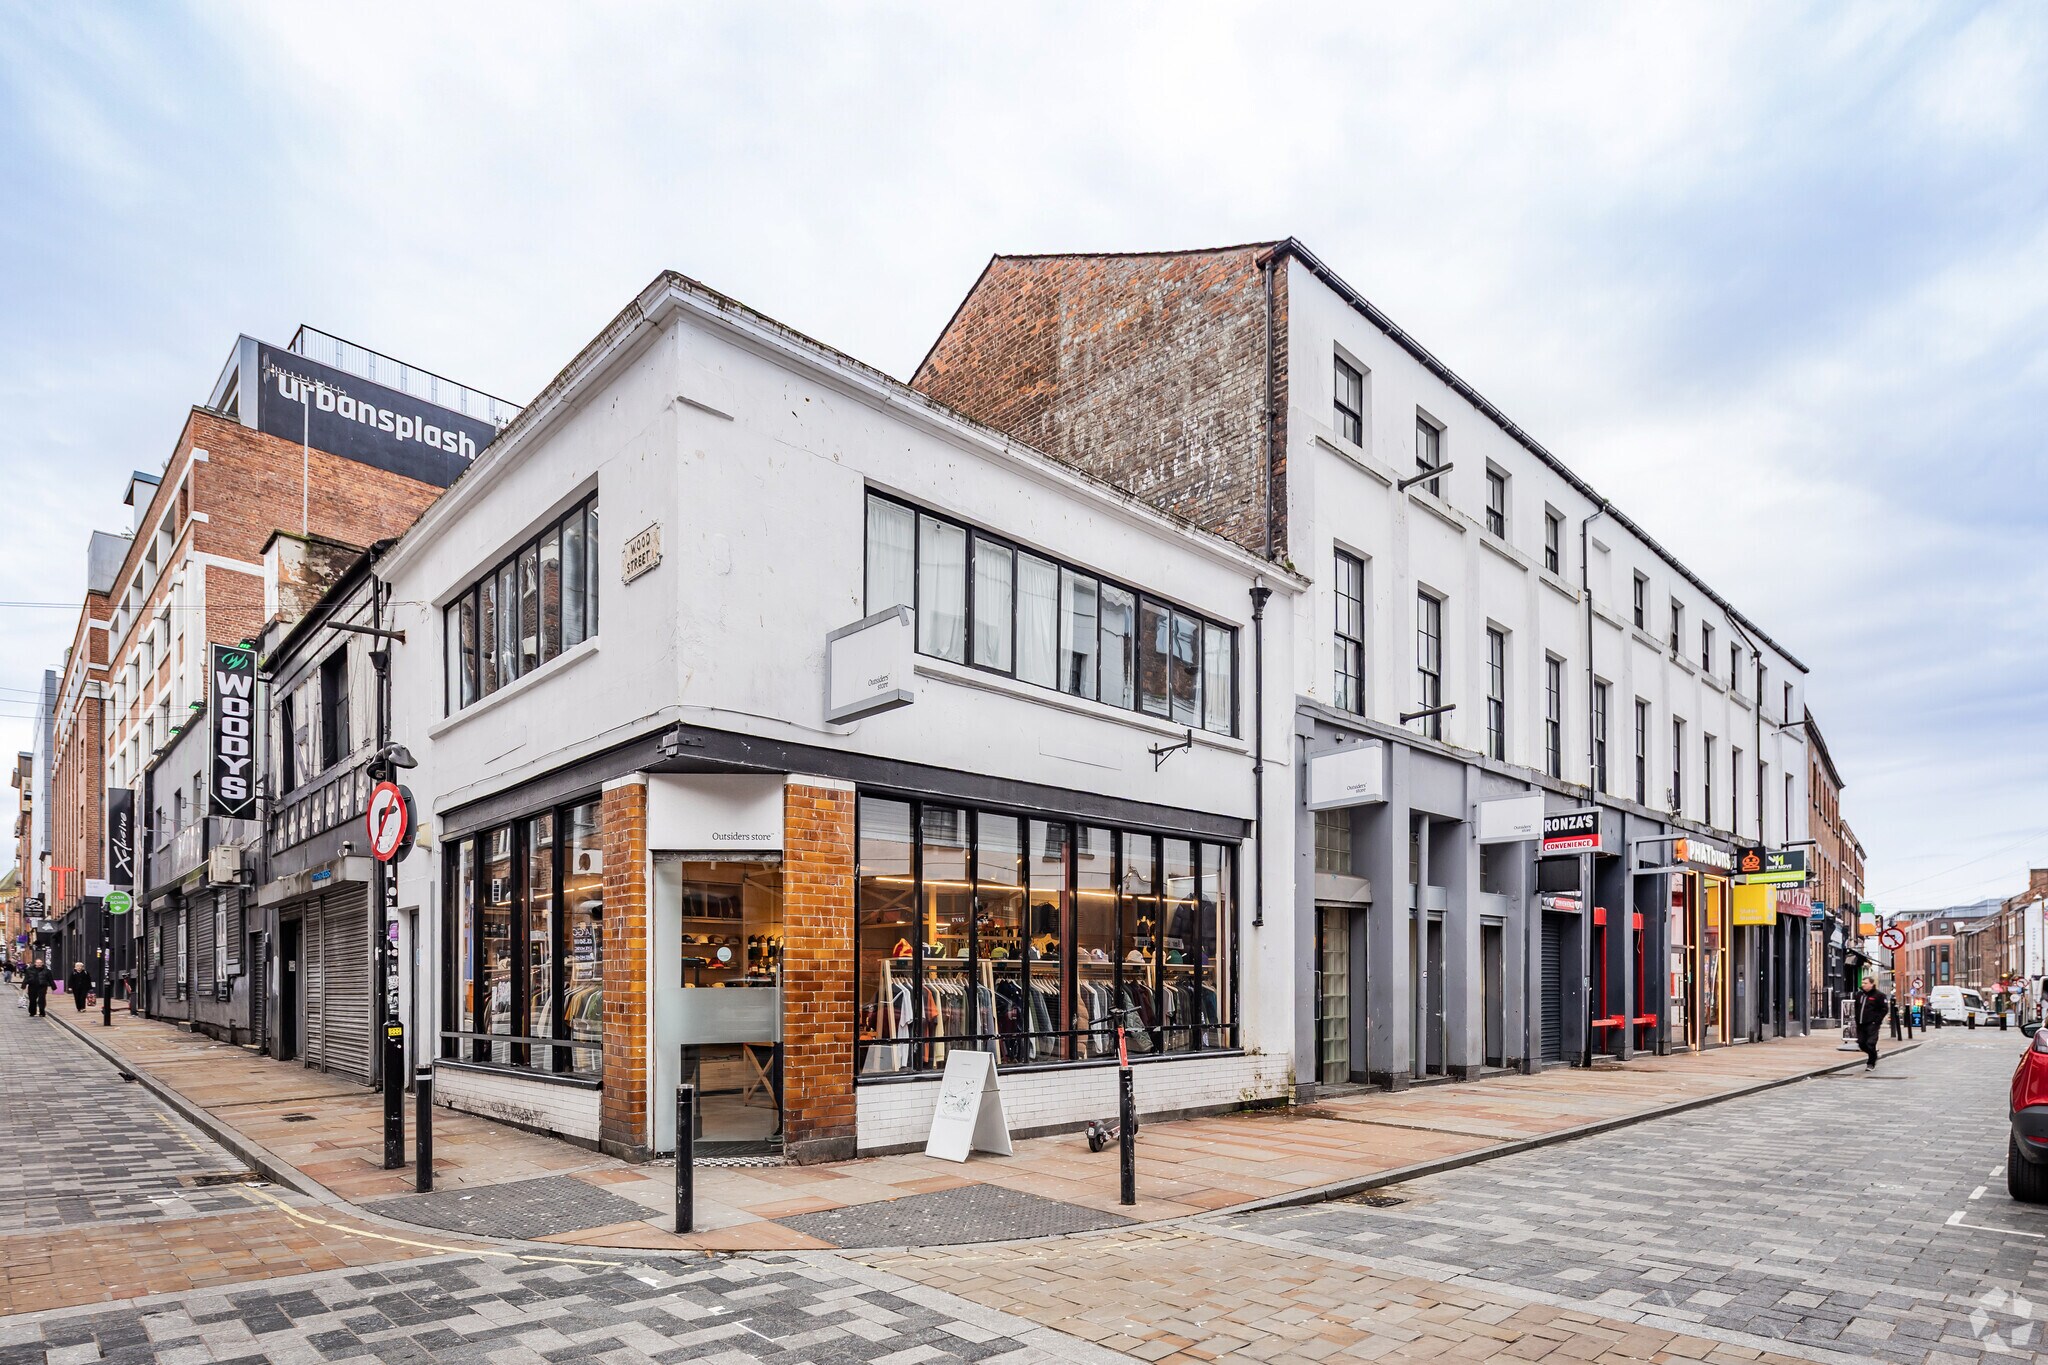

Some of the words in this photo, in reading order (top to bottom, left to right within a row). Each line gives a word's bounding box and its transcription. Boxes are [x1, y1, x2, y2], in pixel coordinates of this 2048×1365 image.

[278, 374, 476, 460] urbansplash
[630, 533, 650, 554] WOOD
[627, 550, 650, 574] STREET
[216, 671, 253, 799] WOODYS
[1544, 814, 1594, 832] RONZA'S
[712, 832, 750, 841] Outsiders
[1546, 840, 1591, 850] CONVENIENCE
